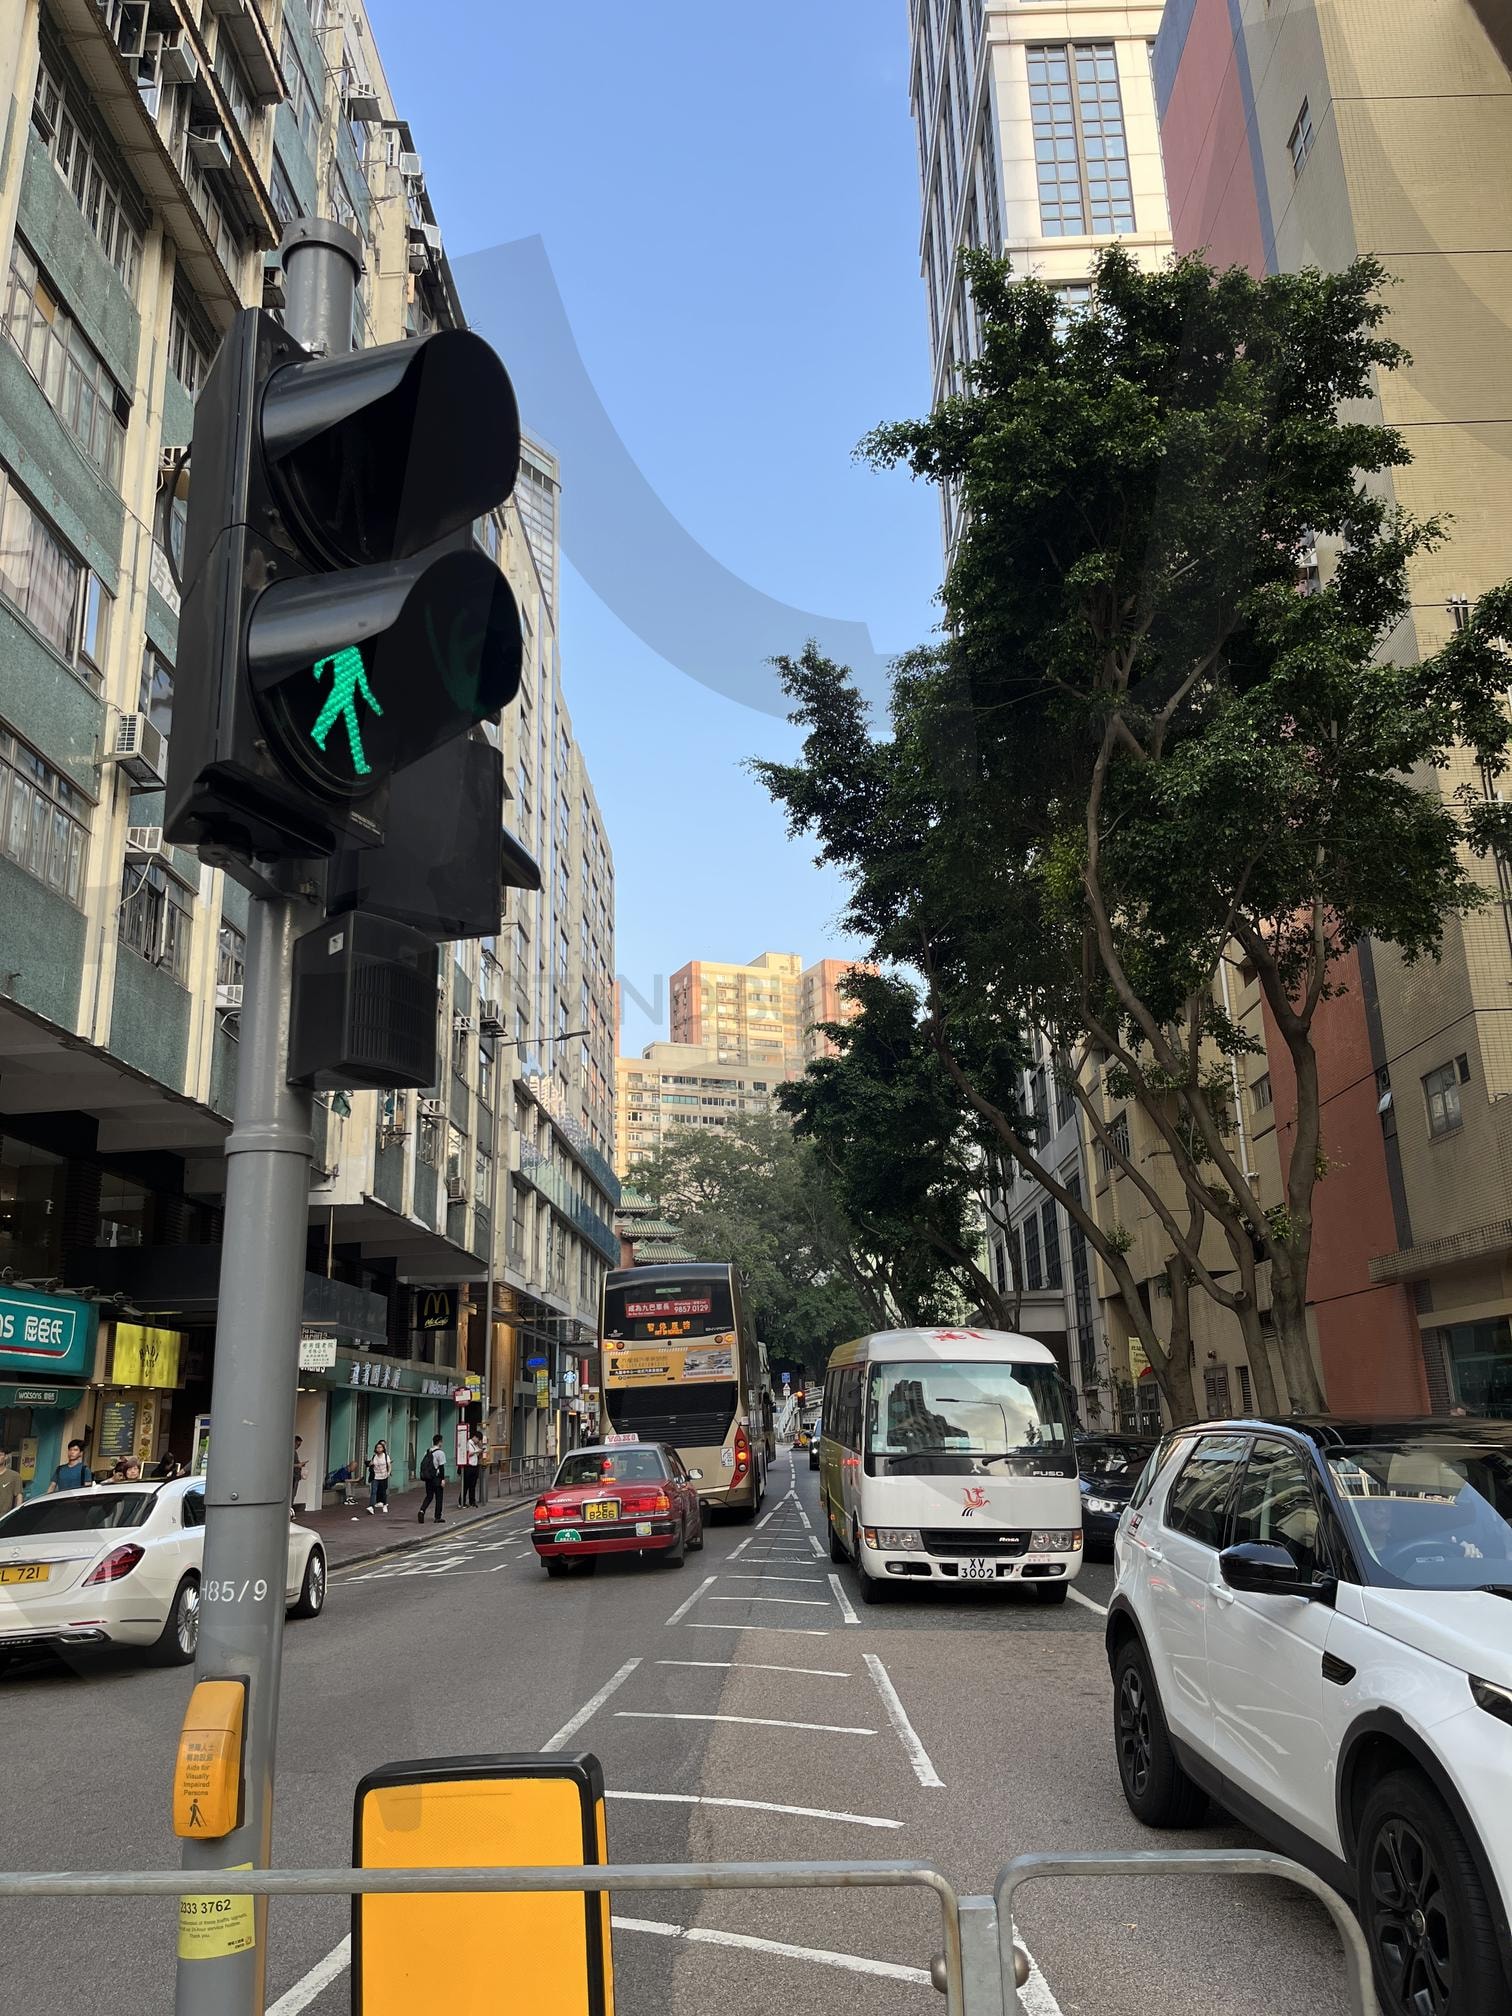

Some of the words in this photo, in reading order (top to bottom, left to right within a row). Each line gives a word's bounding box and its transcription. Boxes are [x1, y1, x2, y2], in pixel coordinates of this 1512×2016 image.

[674, 1305, 690, 1314] 9857
[692, 1304, 709, 1312] 0129
[24, 1316, 64, 1345] 屈臣氏
[18, 1391, 42, 1400] watsons
[608, 1434, 636, 1443] TAXI
[589, 1510, 615, 1520] 8266
[969, 1558, 985, 1569] XV
[0, 1570, 10, 1582] L
[17, 1567, 41, 1581] 721
[961, 1568, 994, 1579] 3002
[201, 1899, 231, 1914] 3762
